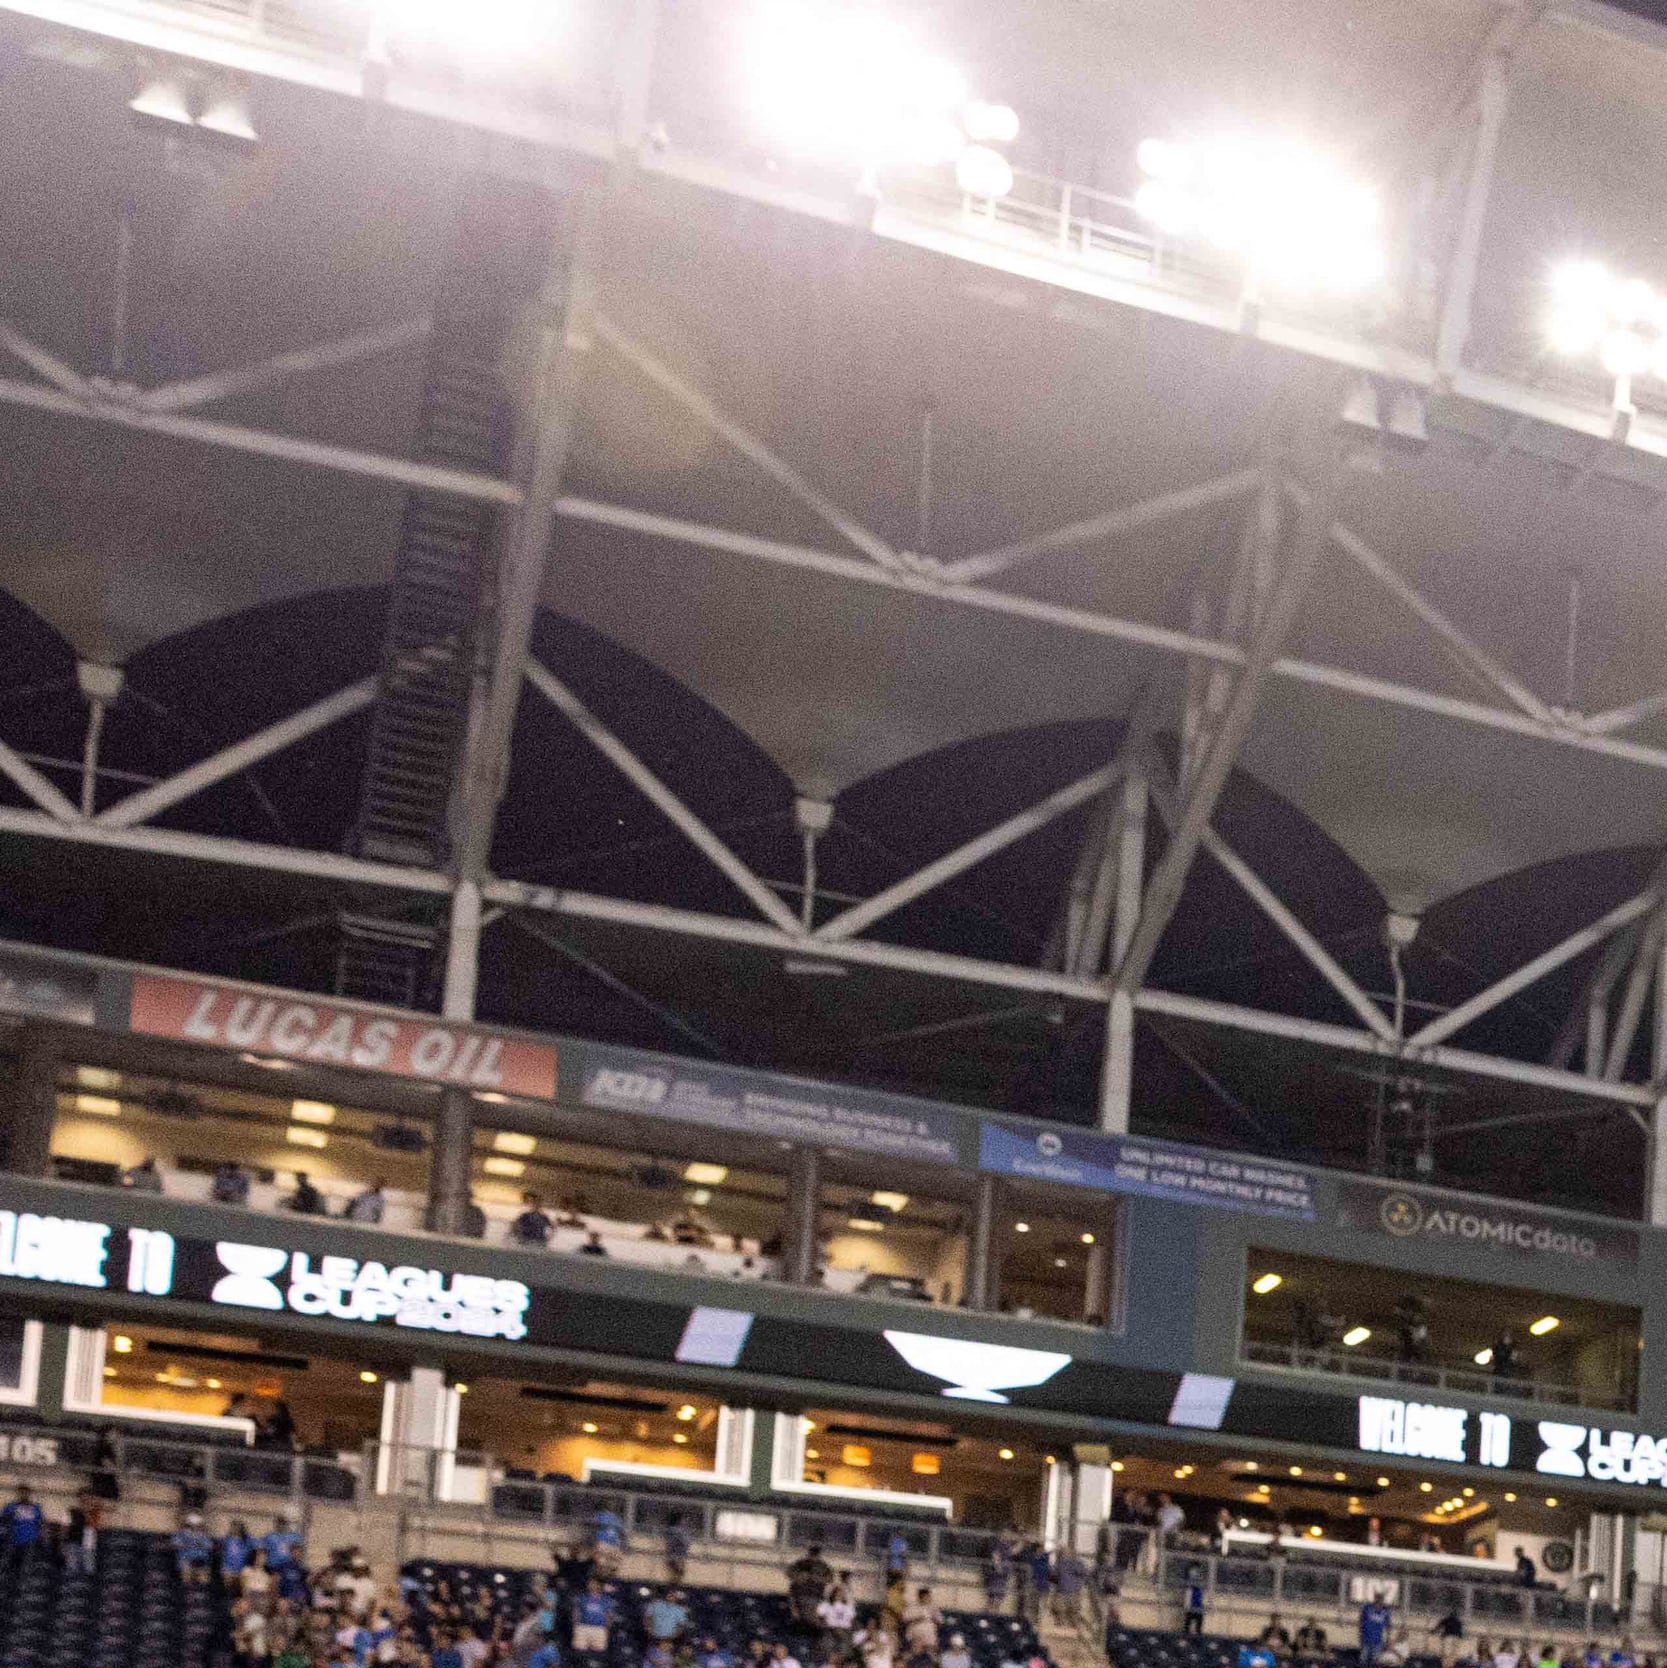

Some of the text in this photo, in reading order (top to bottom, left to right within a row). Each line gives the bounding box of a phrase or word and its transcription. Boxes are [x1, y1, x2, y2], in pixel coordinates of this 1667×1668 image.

[183, 989, 502, 1086] LUCAS OIL
[287, 1281, 400, 1321] CUP
[290, 1251, 530, 1310] LEAGUES
[1588, 1454, 1666, 1484] CUP
